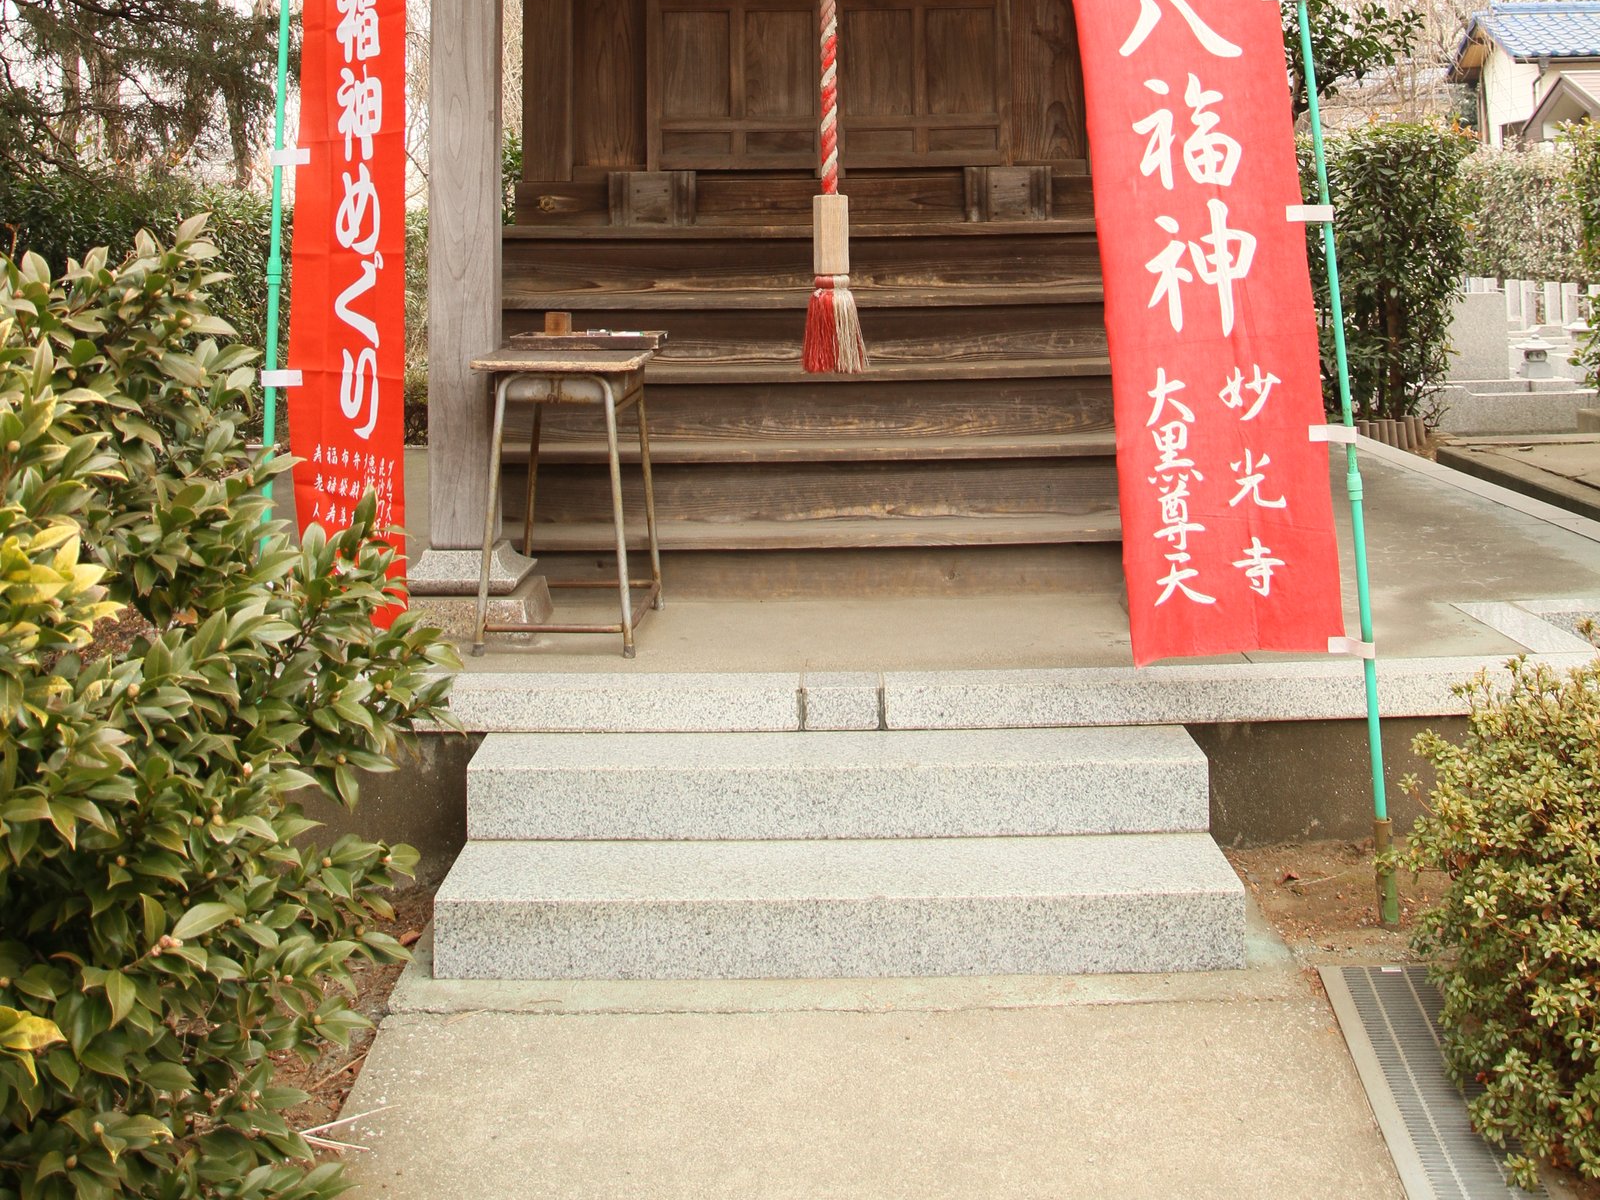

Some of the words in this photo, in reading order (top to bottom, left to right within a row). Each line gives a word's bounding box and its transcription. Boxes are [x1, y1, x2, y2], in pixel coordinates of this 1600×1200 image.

[313, 444, 324, 518] 寿老人
[1145, 367, 1217, 607] 大黒尊天
[1218, 363, 1288, 597] 妙光寺
